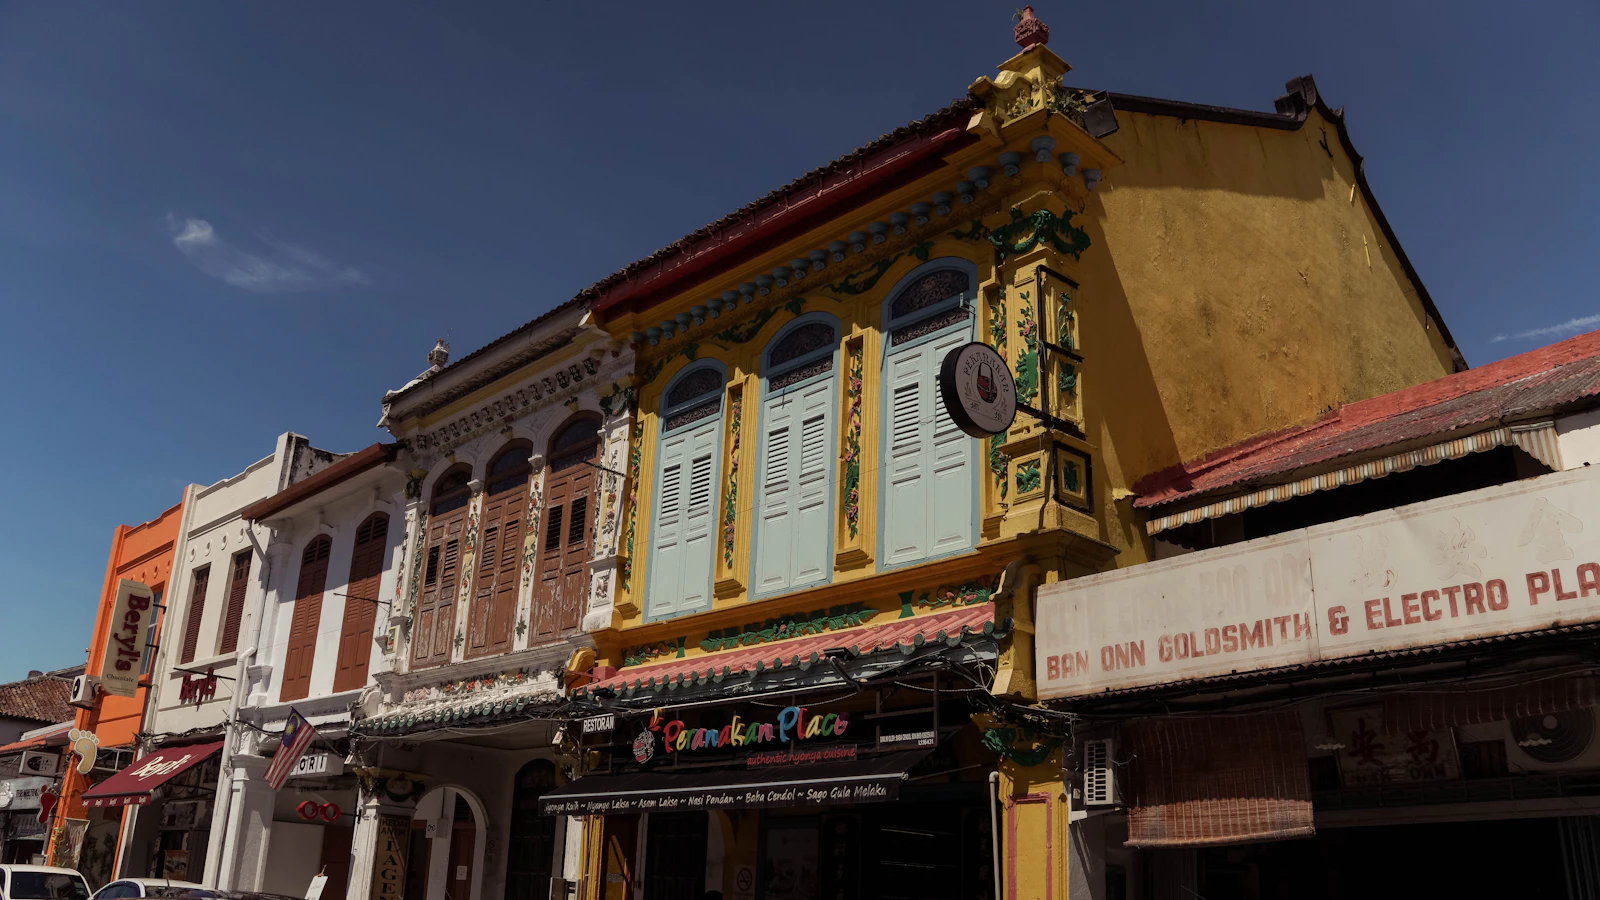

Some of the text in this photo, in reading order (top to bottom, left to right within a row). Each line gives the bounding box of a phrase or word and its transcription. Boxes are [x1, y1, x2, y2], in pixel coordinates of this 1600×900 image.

[114, 593, 150, 671] Beryl's
[1047, 562, 1600, 680] BAN ONN GOLDSMITH & ELECTRO PLA
[106, 673, 135, 683] Chocolate
[583, 716, 615, 733] RESTORAN
[663, 706, 850, 753] Peranakan Place
[747, 746, 857, 766] authentic nyonya cuisine
[565, 801, 579, 812] Kuih
[586, 800, 611, 813] Nyonya
[612, 798, 630, 810] Laksa
[638, 796, 657, 808] Asam
[659, 795, 678, 807] Laksa
[688, 793, 704, 806] Nasi
[705, 792, 734, 805] Pandan
[745, 790, 765, 804] Baba
[767, 788, 796, 802] Cendol
[806, 788, 827, 803] Sago
[830, 785, 851, 799] Gula
[853, 783, 887, 798] Melaka
[380, 827, 406, 836] ANTIK
[382, 818, 408, 828] KEDAI
[379, 840, 402, 900] LAGE
